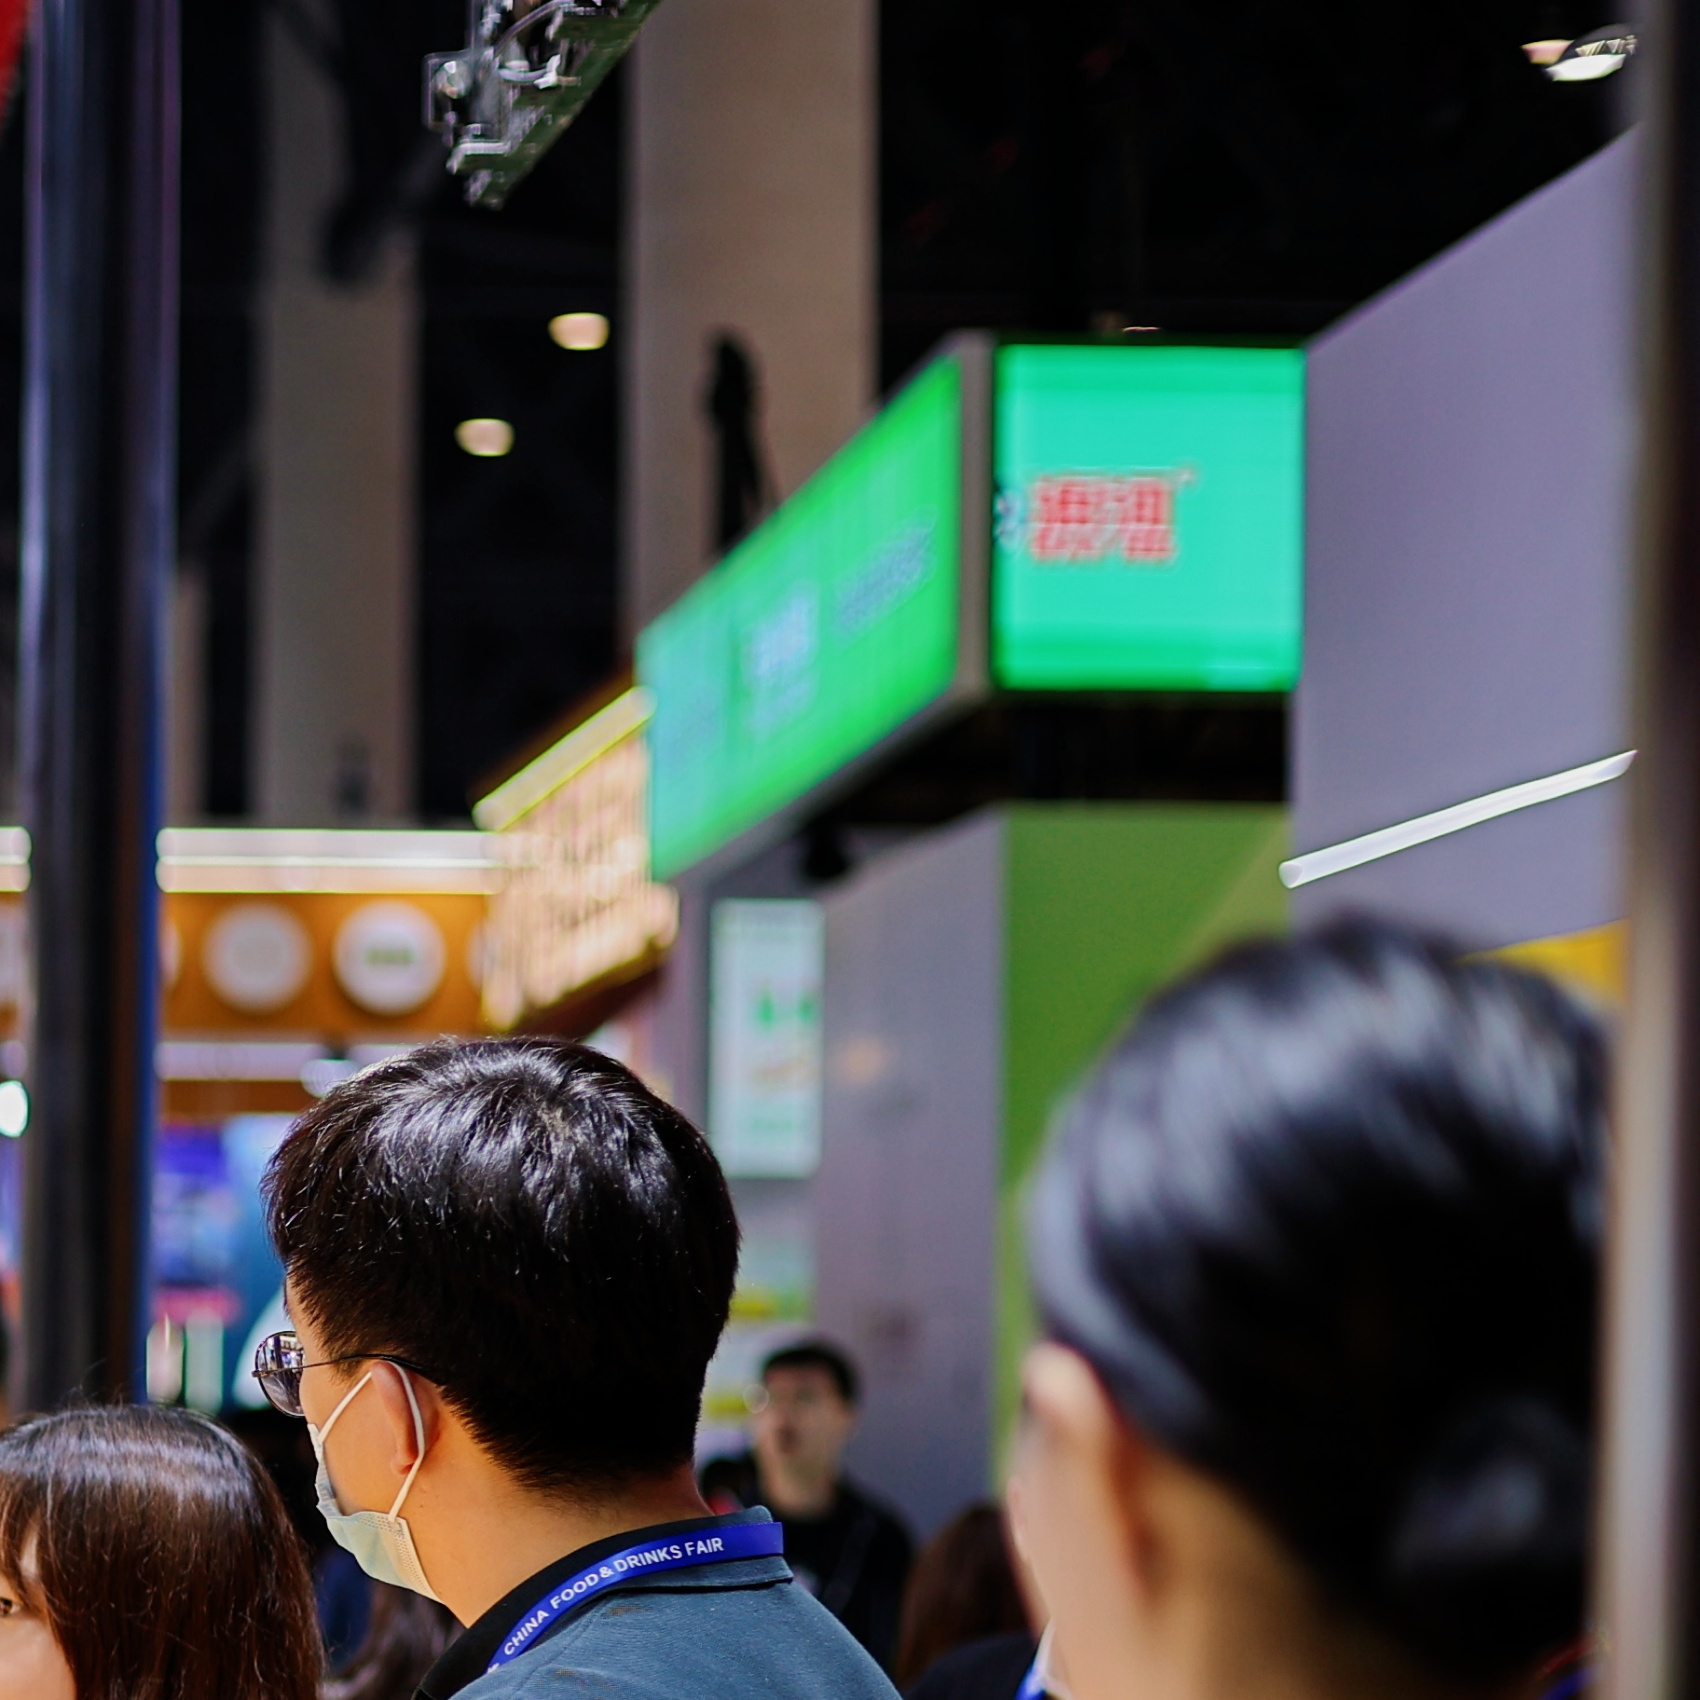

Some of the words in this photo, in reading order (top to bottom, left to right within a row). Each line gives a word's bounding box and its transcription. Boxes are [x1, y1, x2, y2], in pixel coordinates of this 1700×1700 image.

[504, 1609, 550, 1656] CHINA
[550, 1573, 599, 1609] FOOD
[614, 1545, 682, 1573] DRINKS
[685, 1537, 724, 1556] FAIR
